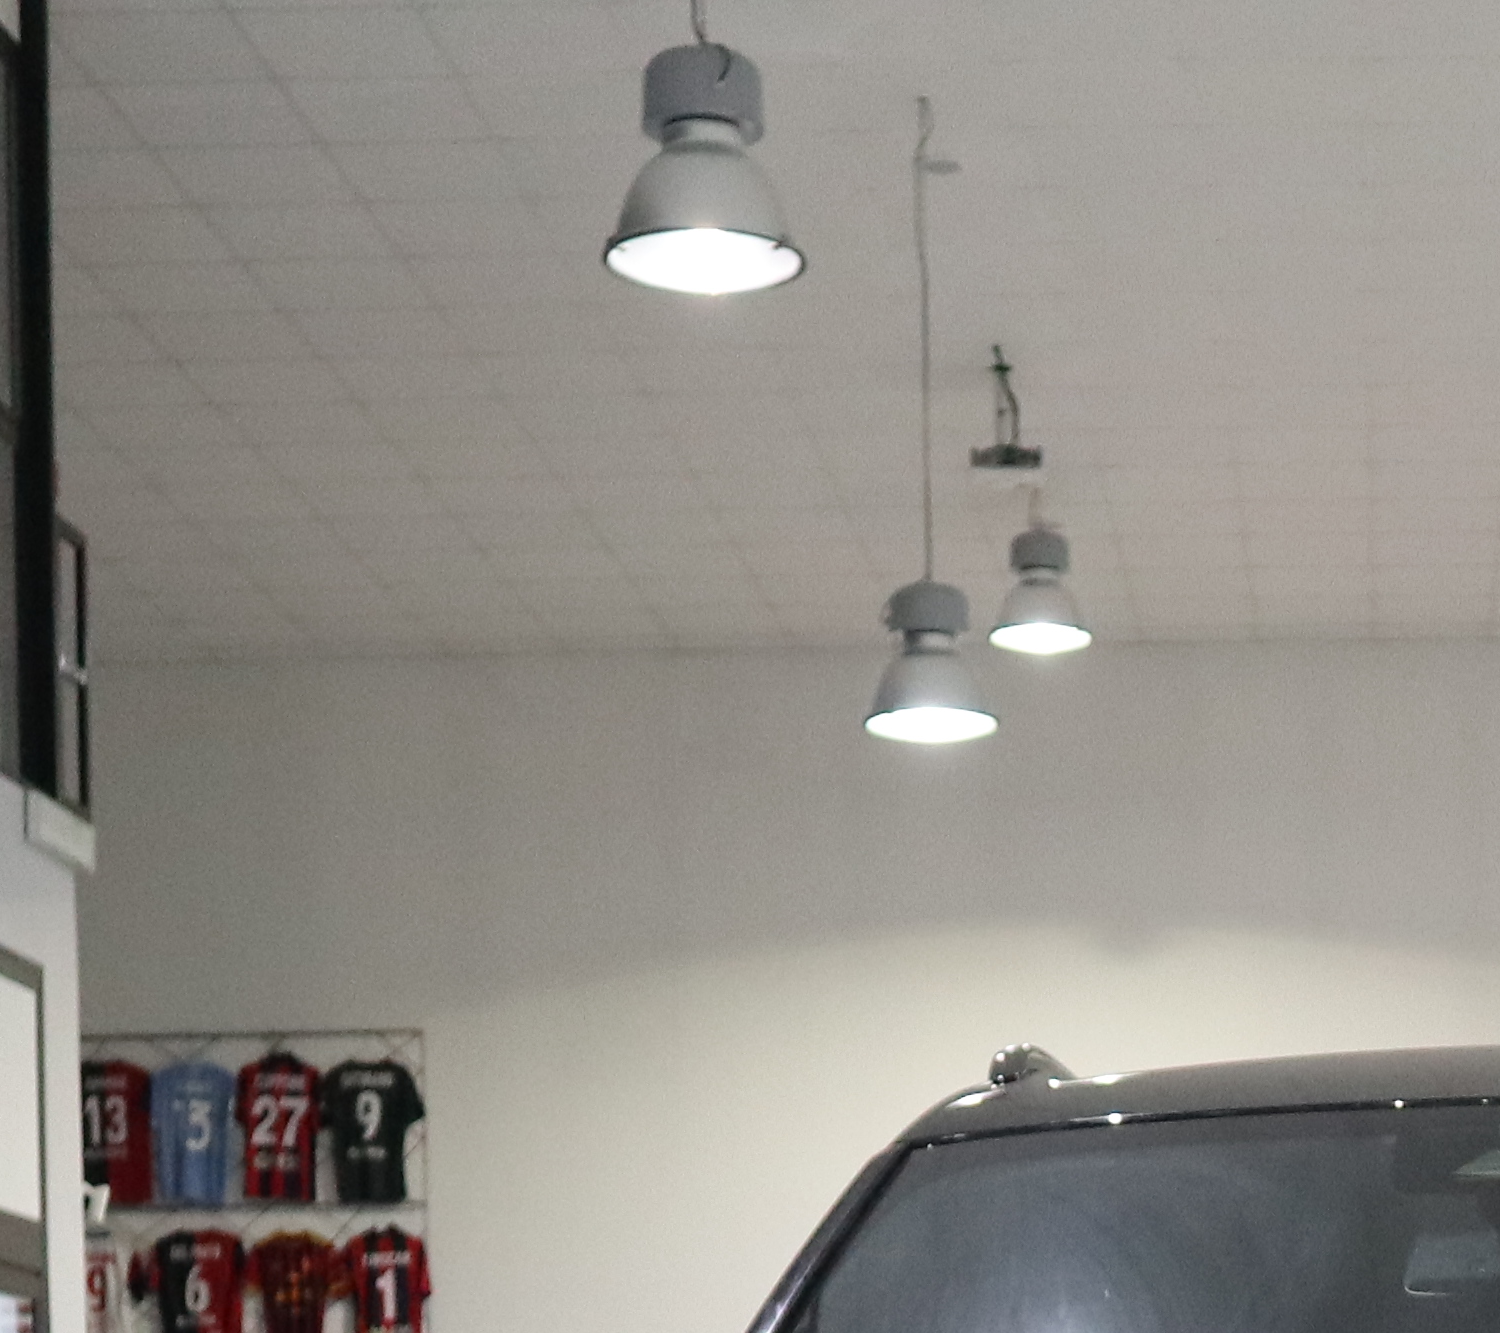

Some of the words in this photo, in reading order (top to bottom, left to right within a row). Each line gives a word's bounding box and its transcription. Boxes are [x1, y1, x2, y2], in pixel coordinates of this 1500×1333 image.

[251, 1094, 309, 1148] 27
[355, 1089, 382, 1141] 9
[184, 1260, 210, 1313] 6
